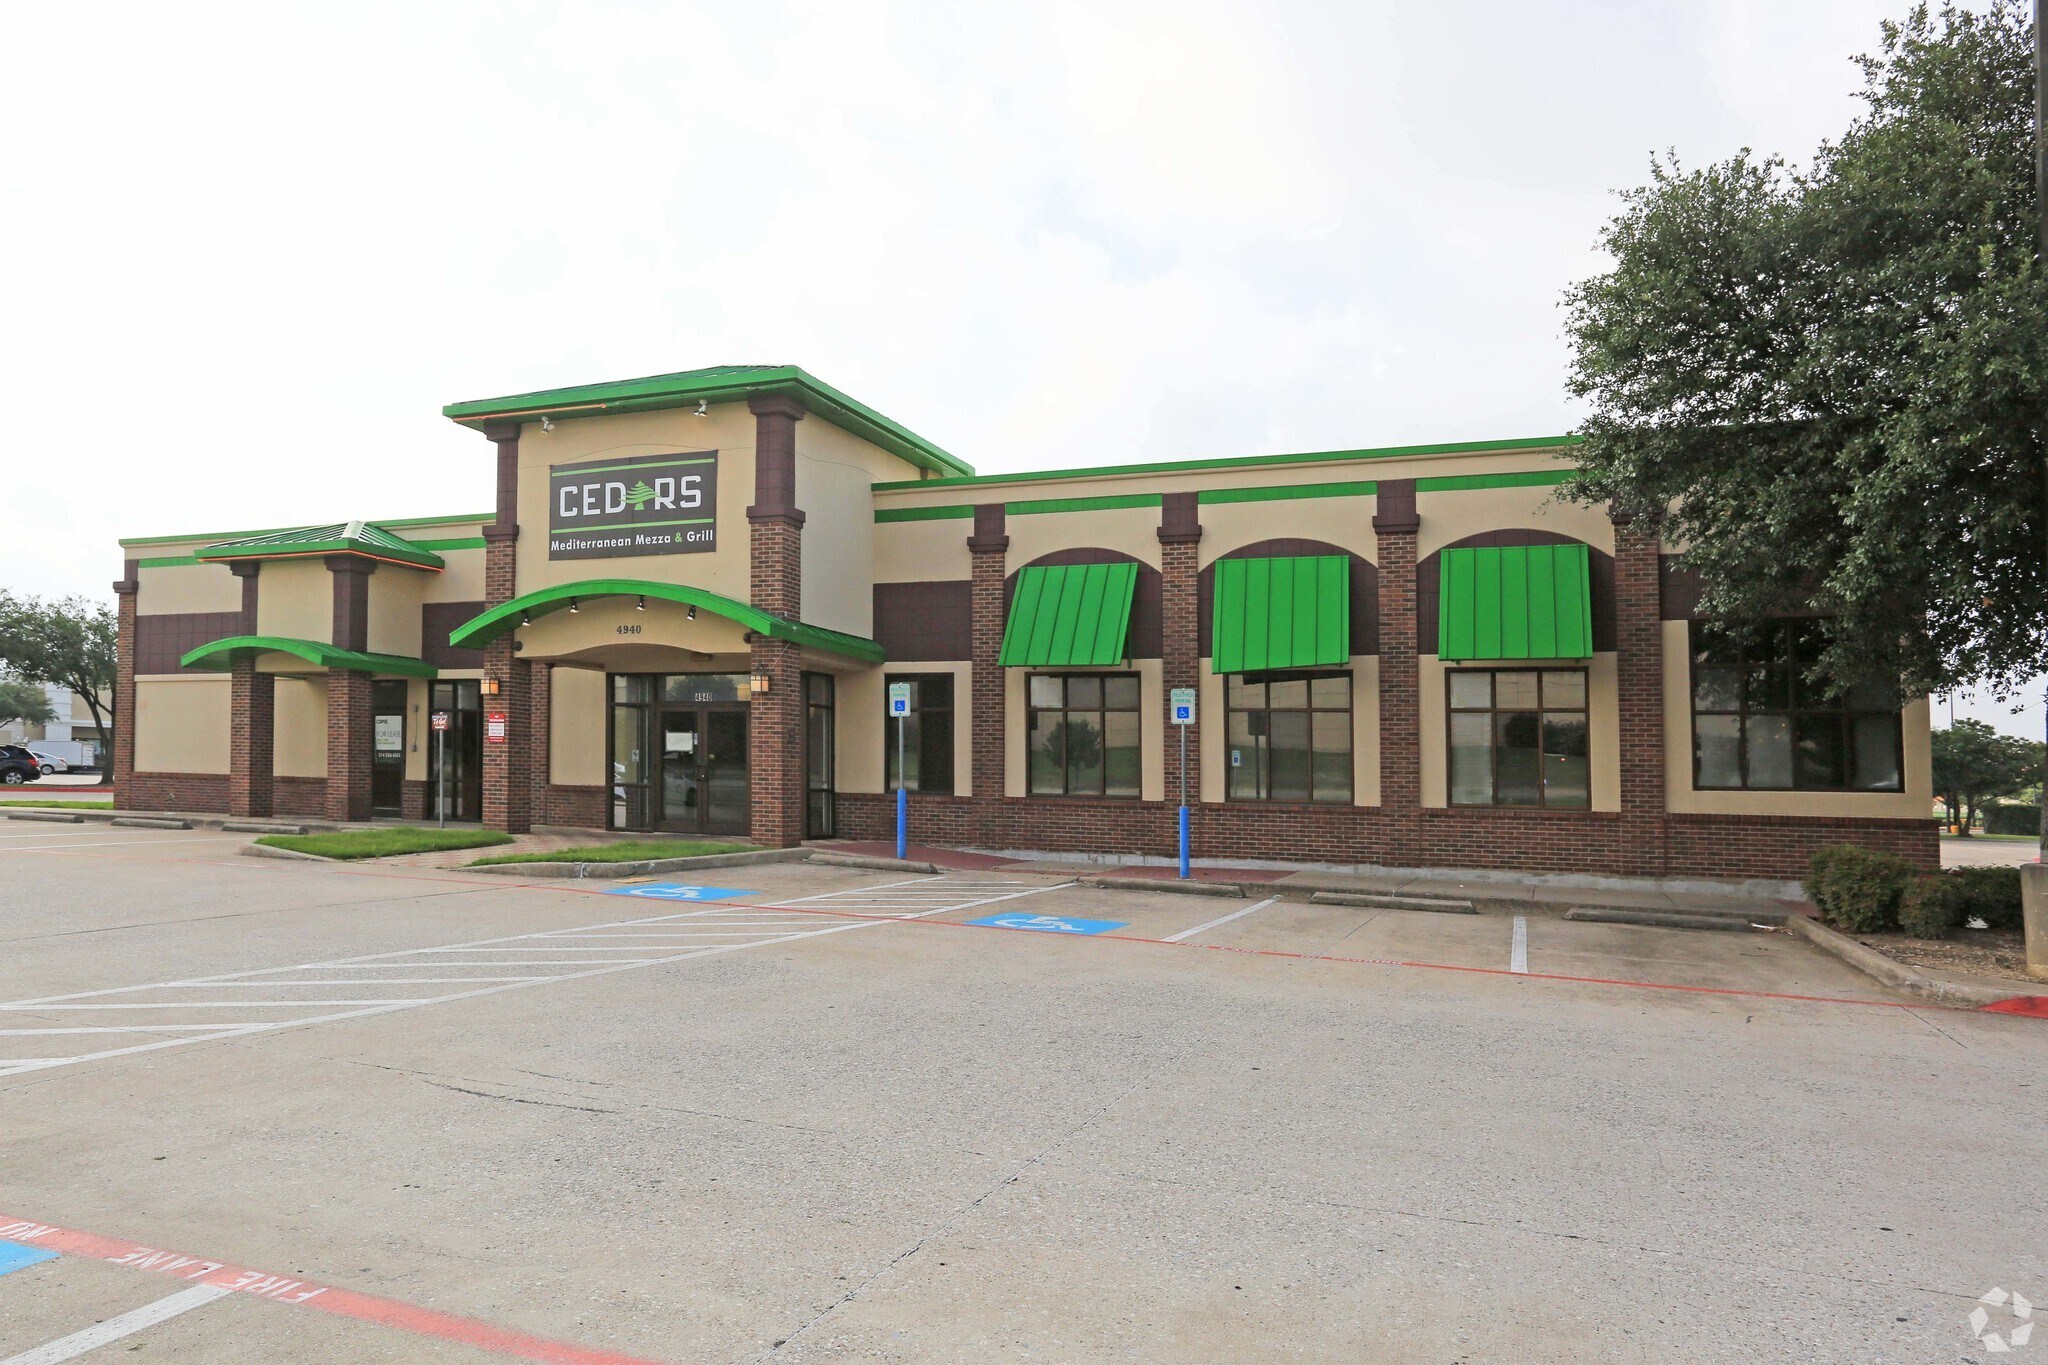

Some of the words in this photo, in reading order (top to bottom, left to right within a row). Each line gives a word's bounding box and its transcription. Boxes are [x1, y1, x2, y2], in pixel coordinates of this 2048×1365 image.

[551, 537, 631, 551] Mediterranean
[635, 534, 671, 546] Mezza
[674, 532, 683, 543] &
[686, 529, 714, 542] Grill
[616, 625, 642, 634] 4940
[695, 693, 712, 701] 4940
[105, 1247, 225, 1279] LANE
[217, 1271, 329, 1304] FIRE
